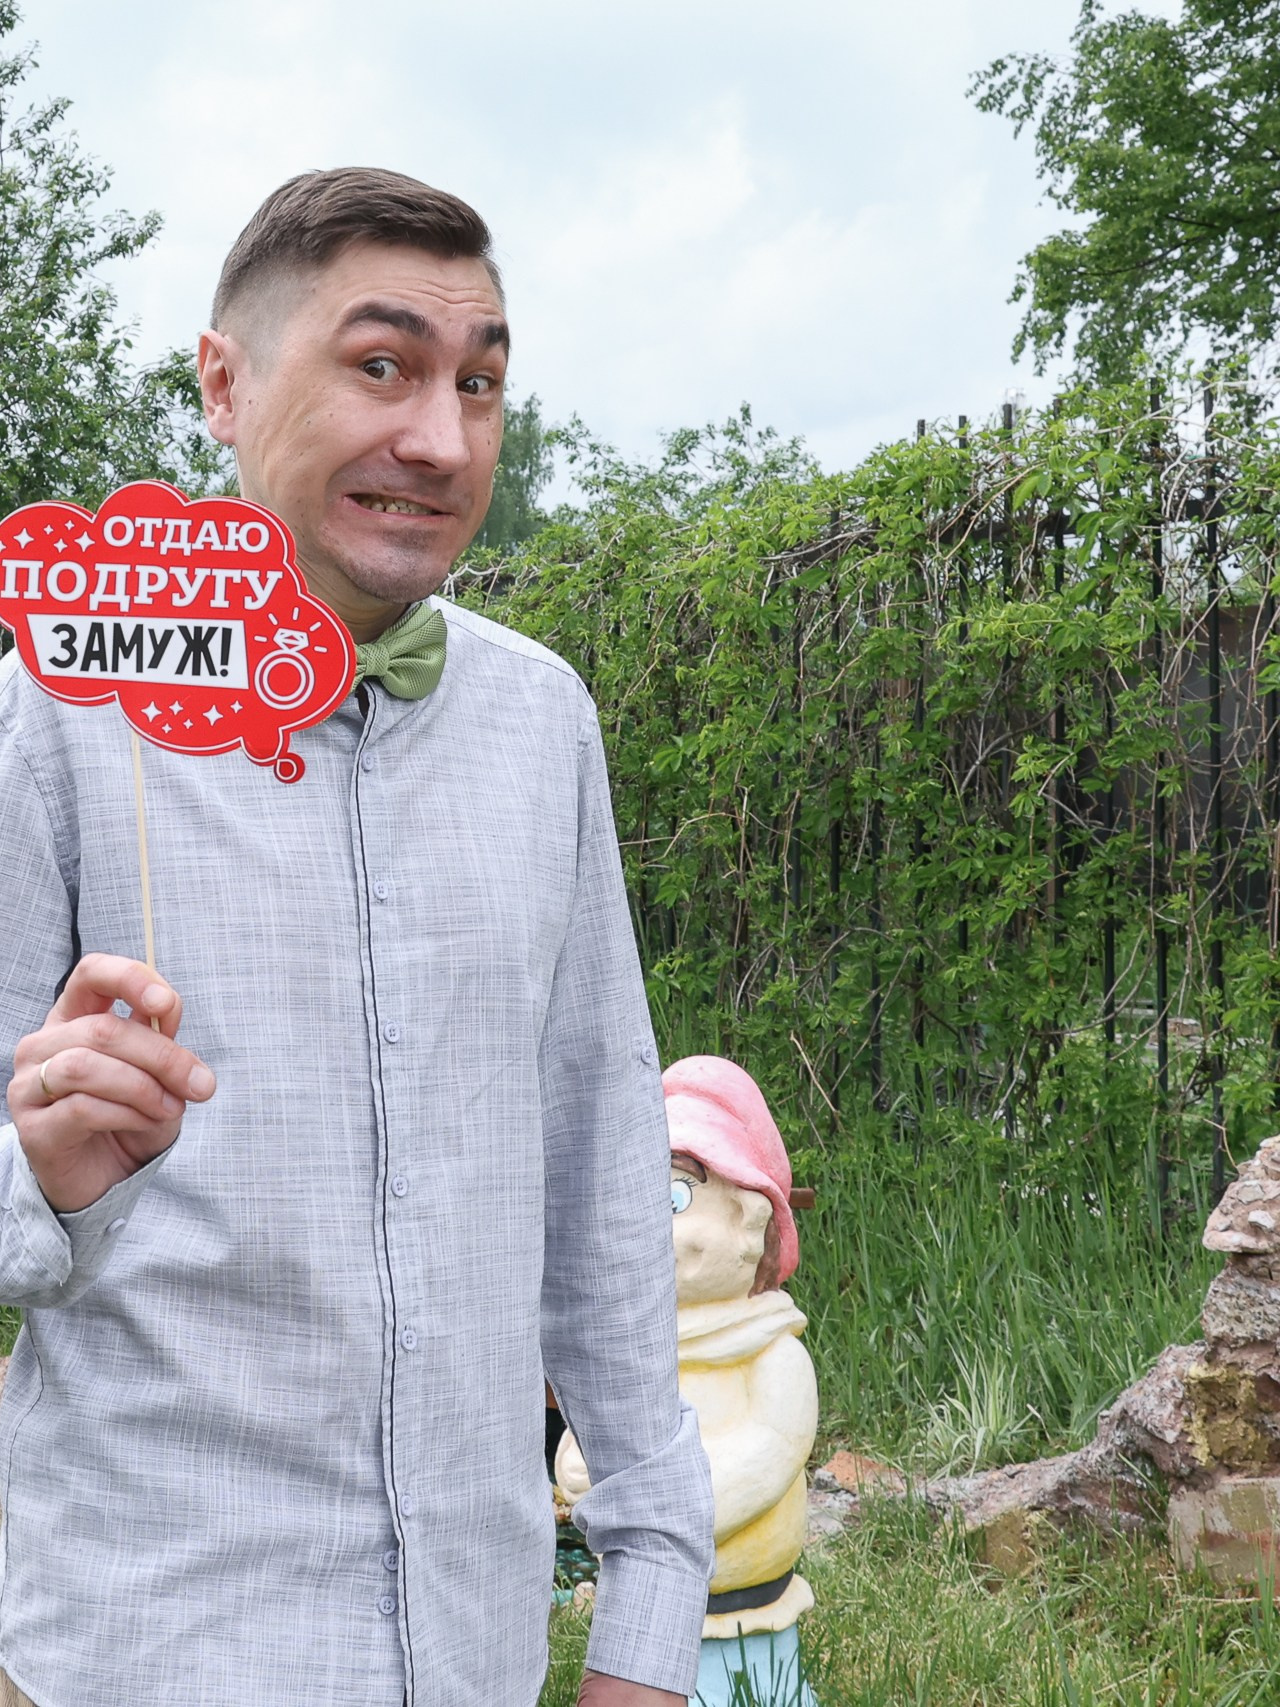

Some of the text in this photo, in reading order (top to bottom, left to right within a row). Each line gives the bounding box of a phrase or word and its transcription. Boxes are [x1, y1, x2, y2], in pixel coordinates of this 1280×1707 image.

[103, 515, 270, 556] ОТДАЮ
[0, 559, 283, 612] ПОДРУГУ
[48, 622, 232, 678] ЗАМУЖ!
